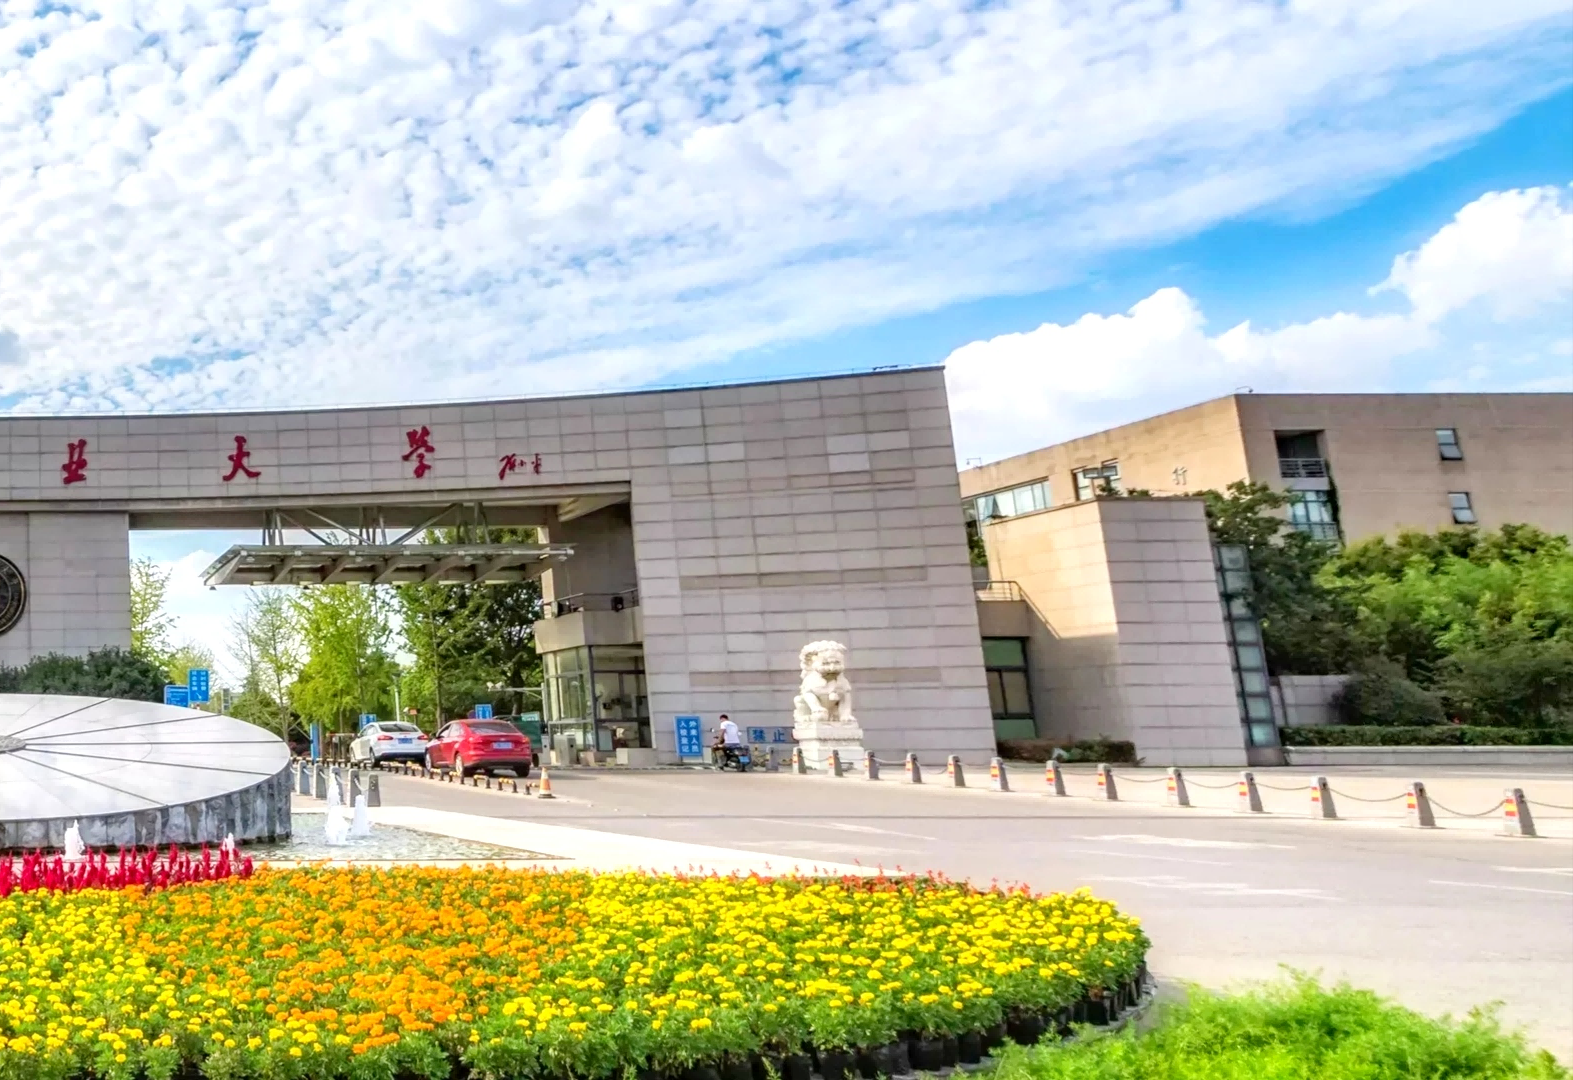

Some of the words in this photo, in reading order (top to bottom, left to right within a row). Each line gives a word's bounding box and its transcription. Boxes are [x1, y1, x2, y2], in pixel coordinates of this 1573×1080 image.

[679, 720, 690, 752] 入校登记
[688, 720, 700, 752] 外来人员
[752, 728, 787, 742] 禁止
